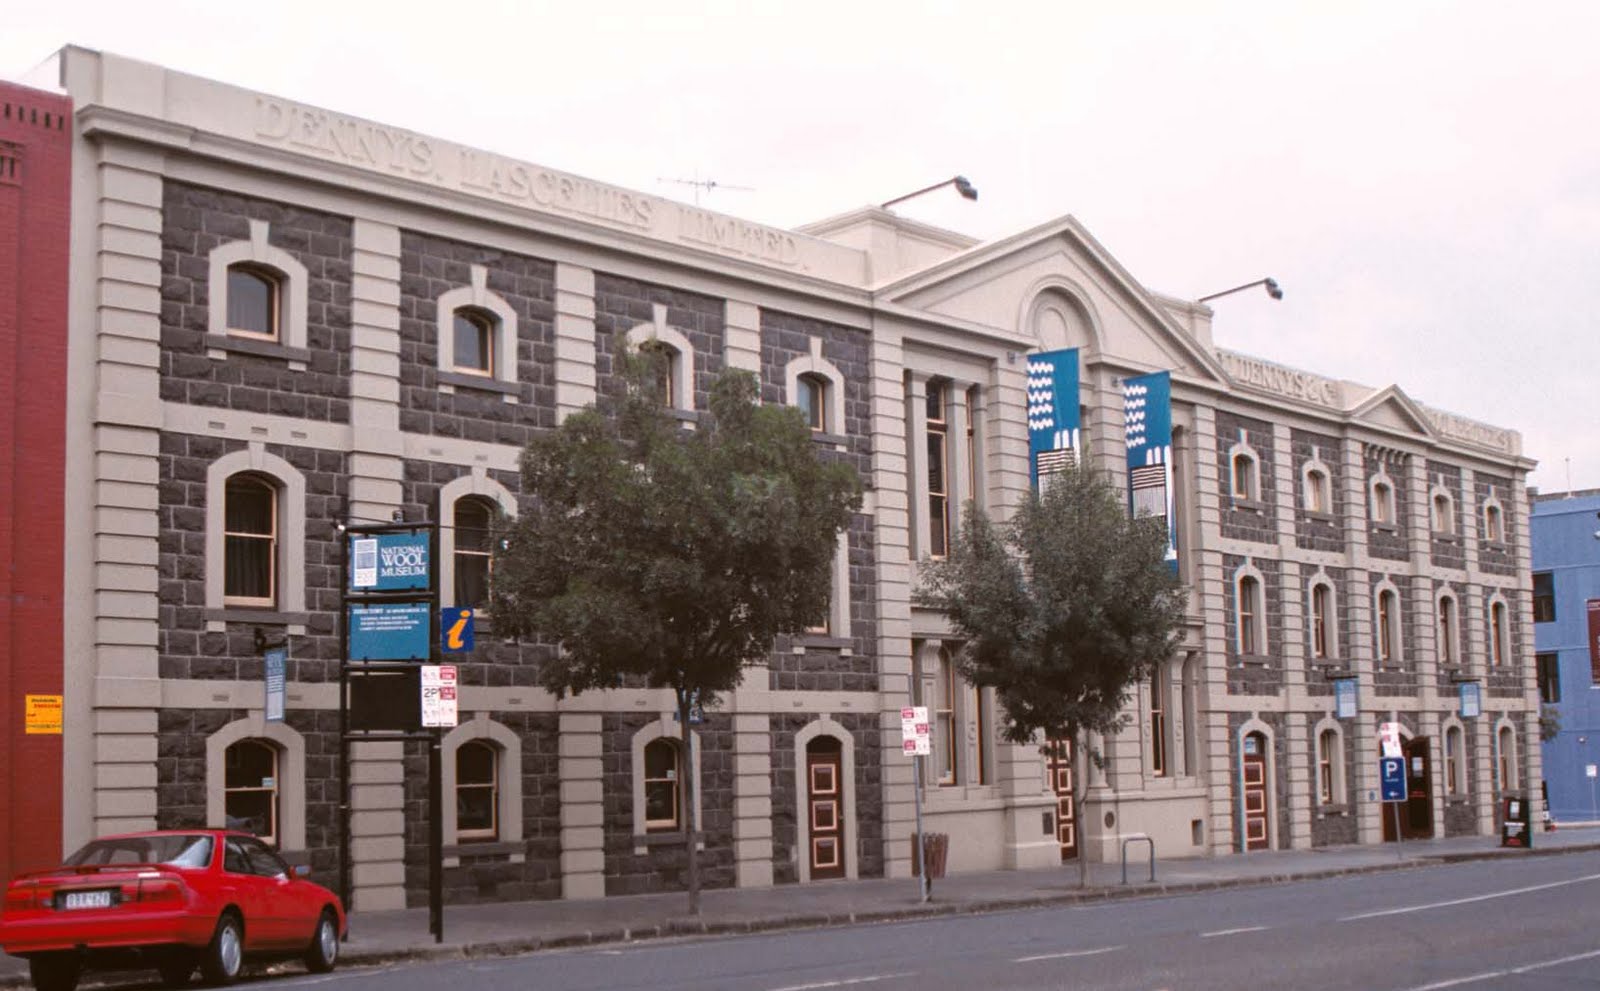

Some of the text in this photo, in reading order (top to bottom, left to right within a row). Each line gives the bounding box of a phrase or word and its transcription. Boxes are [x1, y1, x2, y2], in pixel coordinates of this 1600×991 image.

[381, 545, 426, 556] NATIONAL
[381, 553, 426, 566] WOOL
[381, 566, 426, 576] MUSEUM
[424, 687, 437, 698] 2P
[1386, 761, 1397, 778] P
